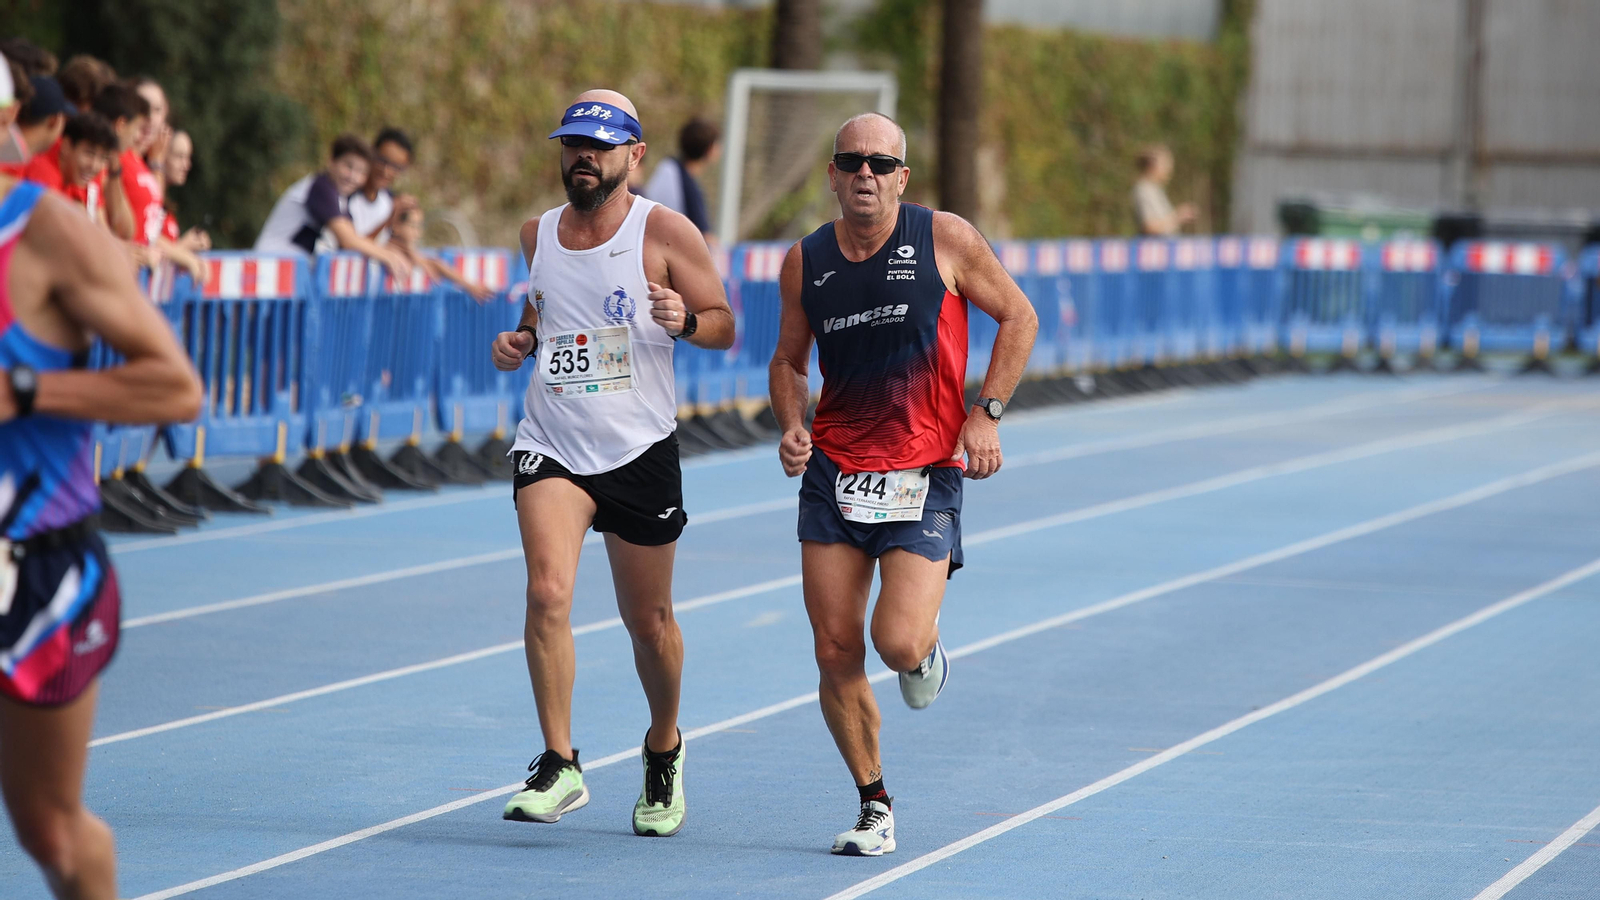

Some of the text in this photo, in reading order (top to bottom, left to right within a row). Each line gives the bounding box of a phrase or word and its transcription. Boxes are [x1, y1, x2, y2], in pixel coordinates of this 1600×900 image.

[823, 304, 909, 334] Vanessa
[871, 317, 905, 327] CALZADOS
[549, 348, 590, 375] 535
[843, 473, 887, 500] 244
